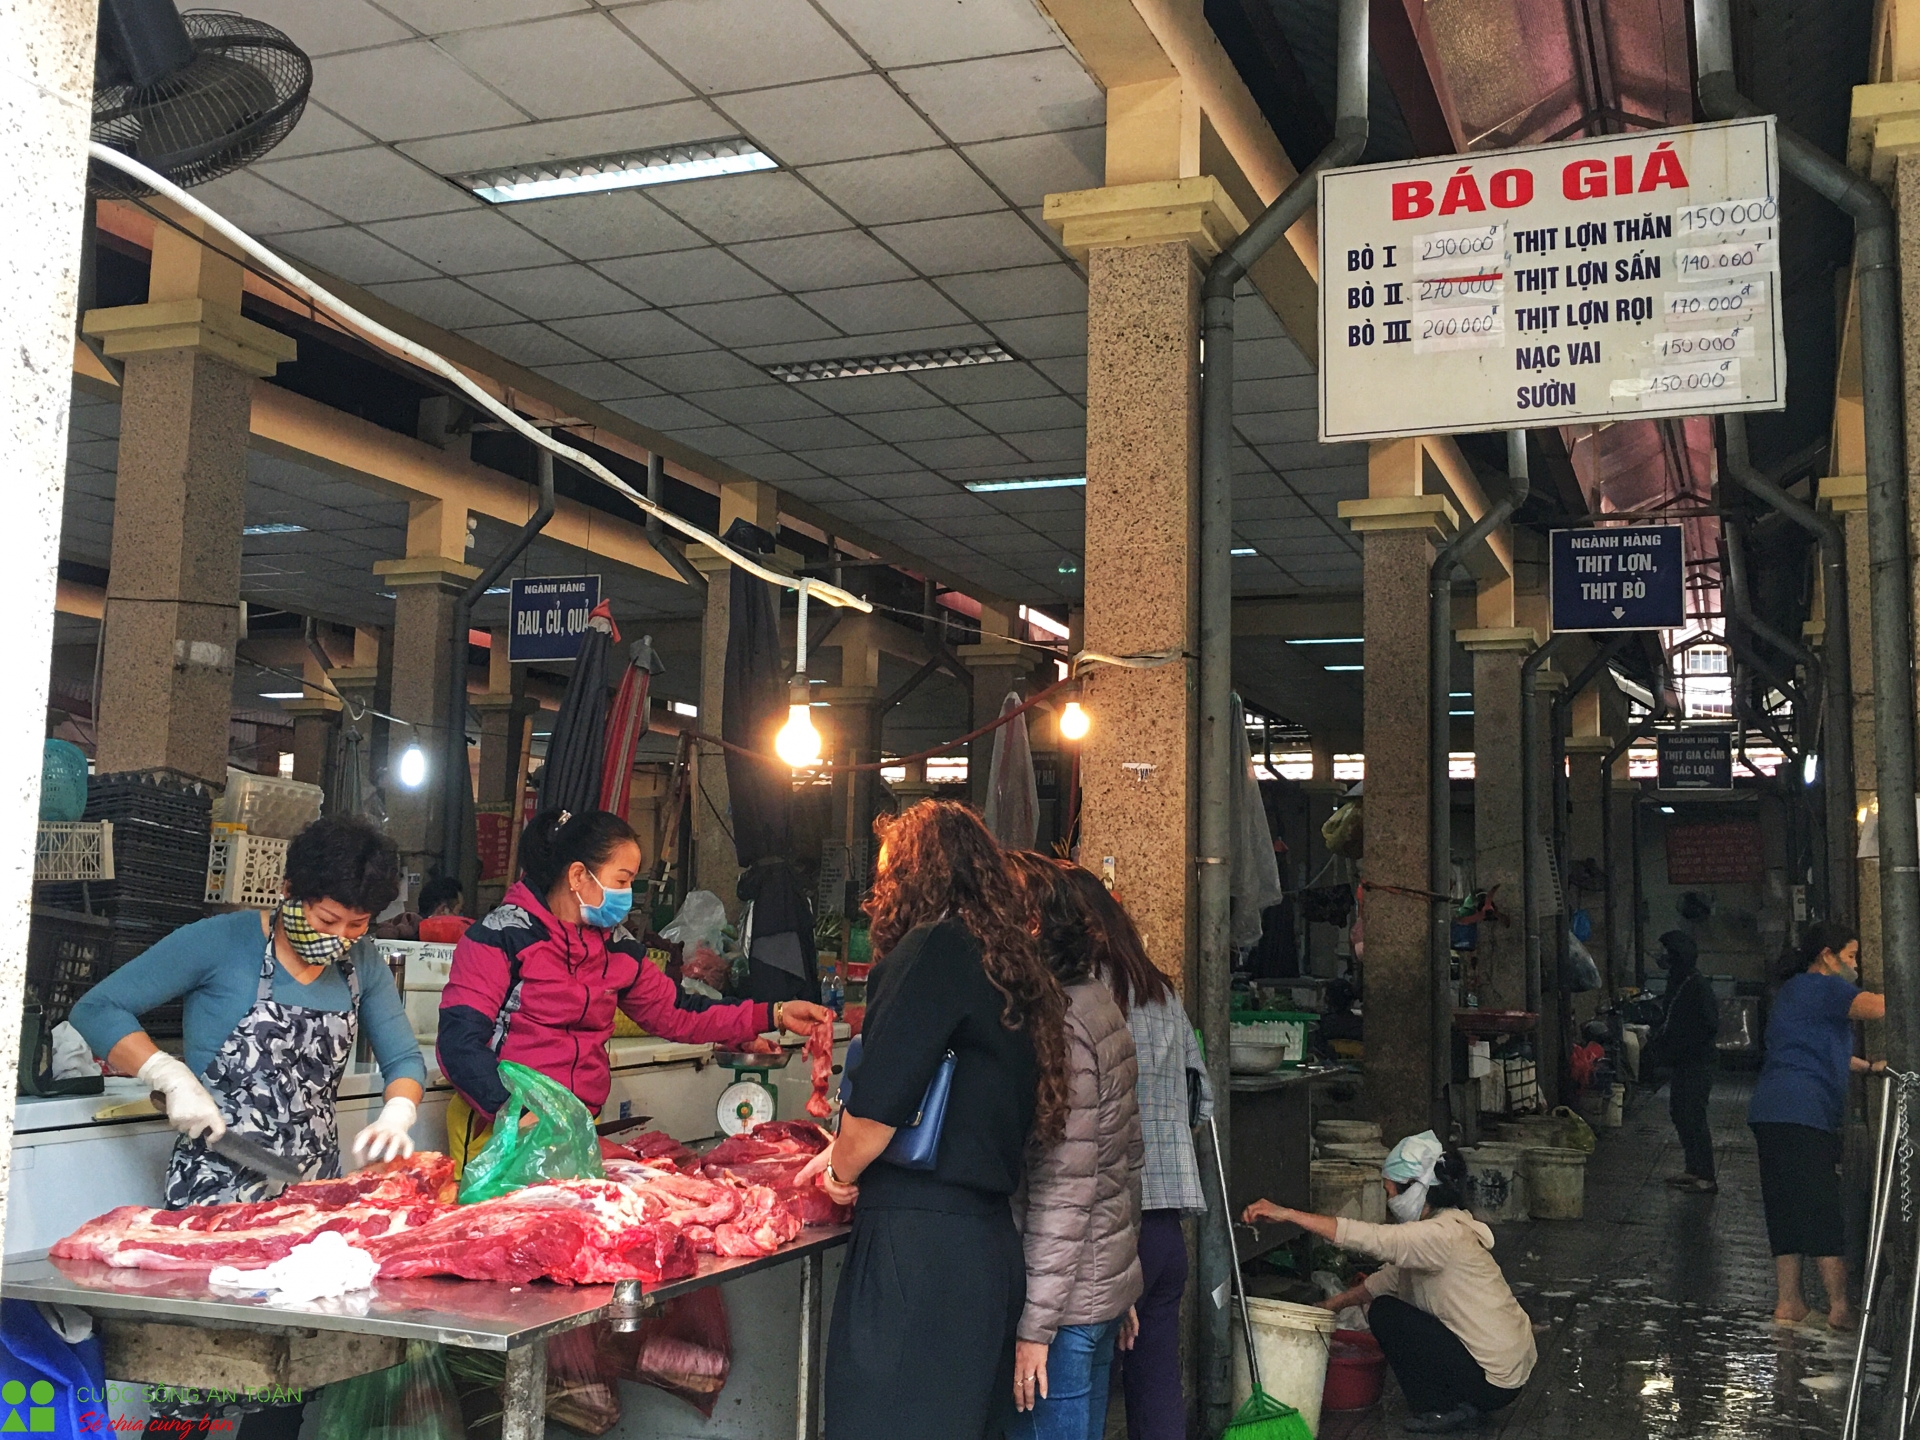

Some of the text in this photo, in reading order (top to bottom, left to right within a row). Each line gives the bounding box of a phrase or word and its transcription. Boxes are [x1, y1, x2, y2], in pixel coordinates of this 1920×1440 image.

[1391, 140, 1690, 221] BÁO GIÁ
[1513, 227, 1559, 256] THỊT
[1565, 221, 1607, 252] LỢN
[1613, 212, 1672, 243] THĂN
[1347, 242, 1374, 271] BÒ
[1382, 245, 1397, 268] I
[1513, 266, 1559, 295] THỊT
[1565, 260, 1608, 291] LỢN
[1615, 249, 1661, 283] SẤN
[1347, 280, 1374, 309] BÒ
[1383, 282, 1404, 306] II
[1514, 305, 1560, 334] THỊT
[1566, 300, 1609, 330] LỢN
[1616, 296, 1653, 325] RỌI
[1348, 318, 1375, 347] BÒ
[1382, 319, 1412, 344] III
[1516, 344, 1560, 373] NẠC
[1566, 341, 1601, 366] VAI
[1516, 378, 1576, 409] SƯỜN
[1571, 532, 1662, 549] NGÀNH HÀNG
[1576, 552, 1658, 577] THỊT LỢN,
[524, 581, 586, 594] NGÀNH HÀNG
[1581, 577, 1646, 603] THỊT BÒ
[517, 610, 543, 637] RAU,
[545, 600, 565, 637] CỦ,
[1664, 750, 1683, 763] THỊT
[1686, 750, 1702, 760] GIA
[1672, 763, 1715, 777] CÁC LOẠI
